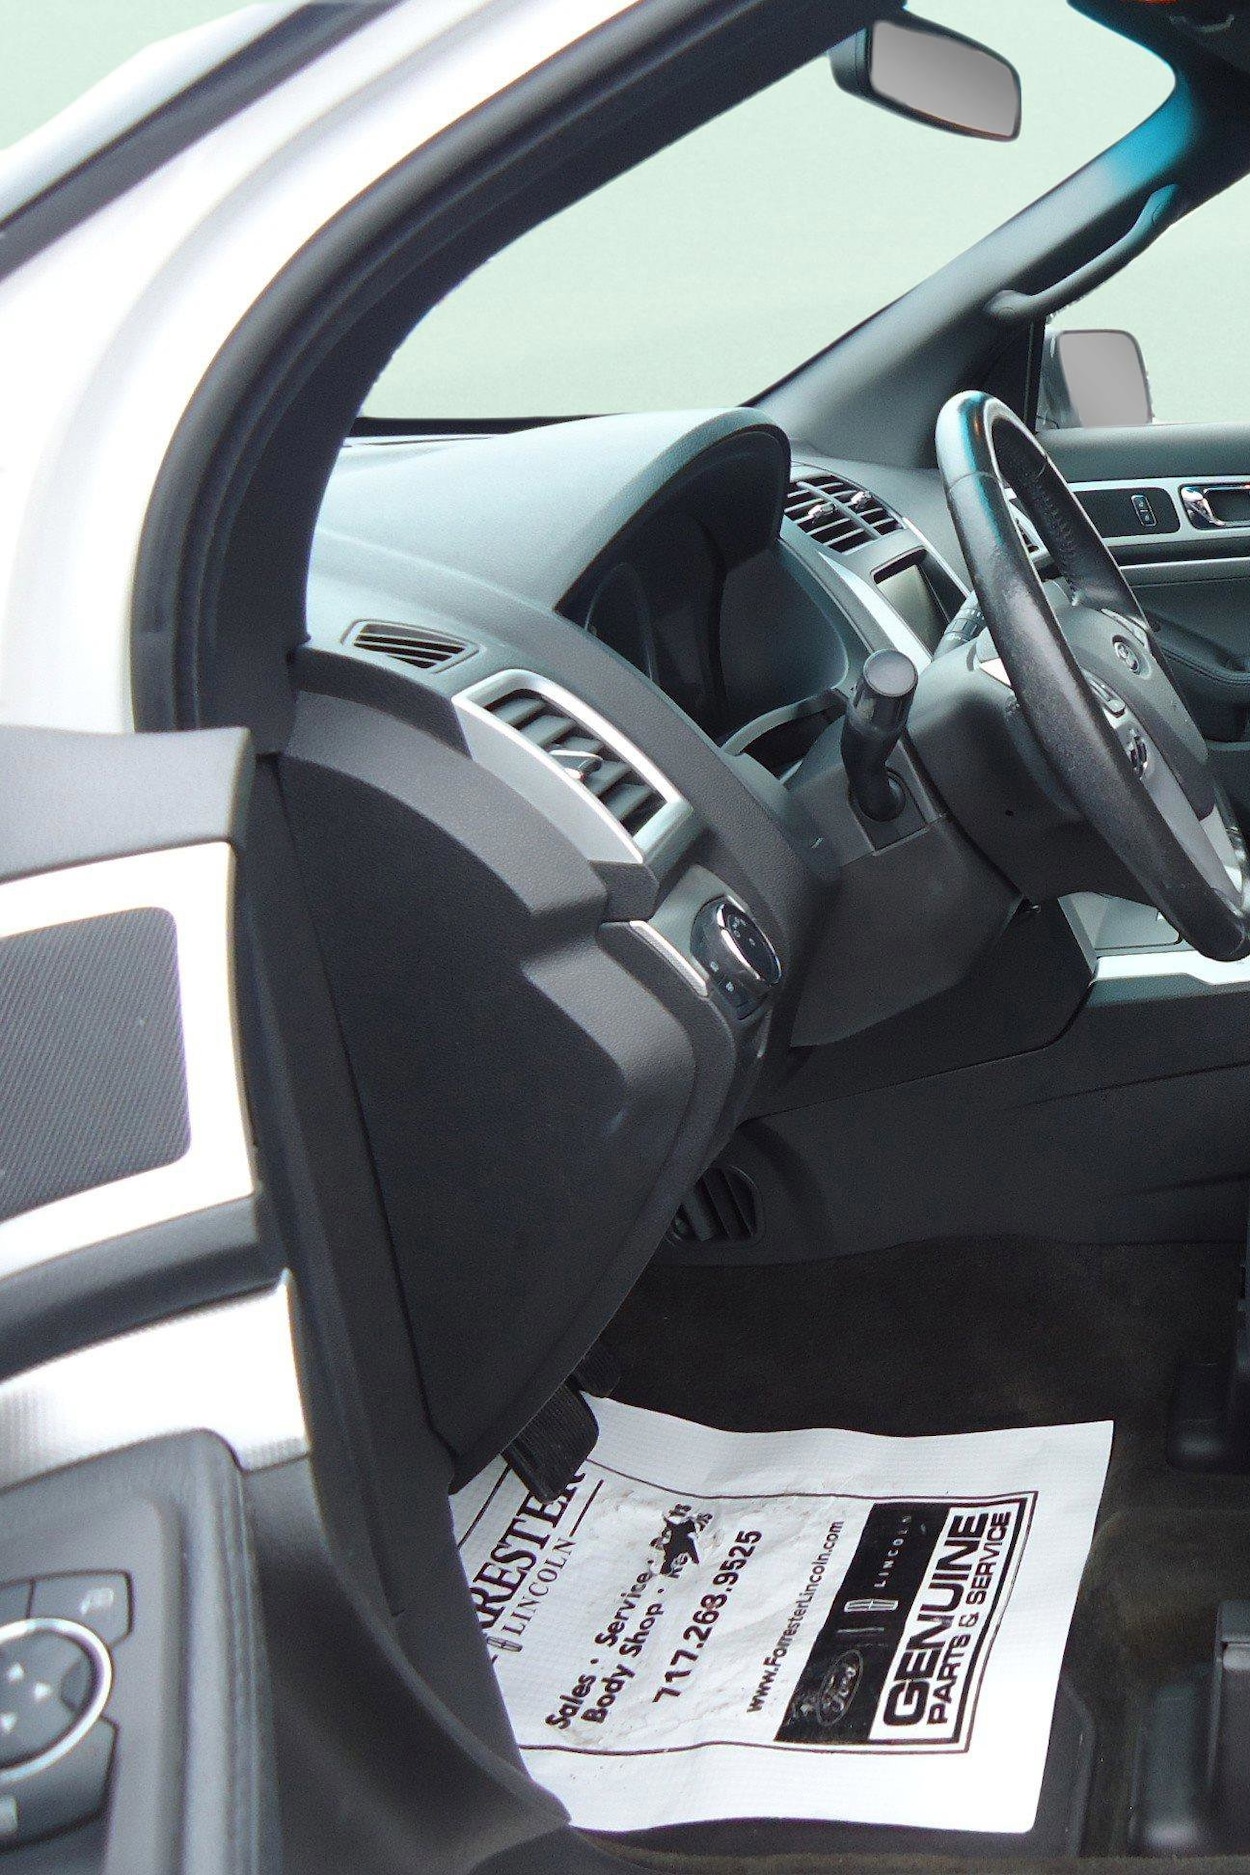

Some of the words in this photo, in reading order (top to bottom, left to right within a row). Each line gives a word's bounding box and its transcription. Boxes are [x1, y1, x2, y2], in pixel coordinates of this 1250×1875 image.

[470, 1473, 586, 1629] RESTE
[502, 1537, 577, 1637] LINCOLN
[873, 1515, 912, 1589] LINCOLN
[966, 1511, 1012, 1606] SERVICE
[545, 1673, 597, 1730] Sales
[594, 1571, 653, 1648] Service
[581, 1664, 636, 1724] Body
[619, 1603, 665, 1658] Shop
[652, 1530, 763, 1703] 717.268.9525
[747, 1520, 845, 1714] www.ForresterLincoln.com
[883, 1511, 989, 1726] GENUINE
[959, 1612, 980, 1628] &
[927, 1633, 972, 1725] PARTS
